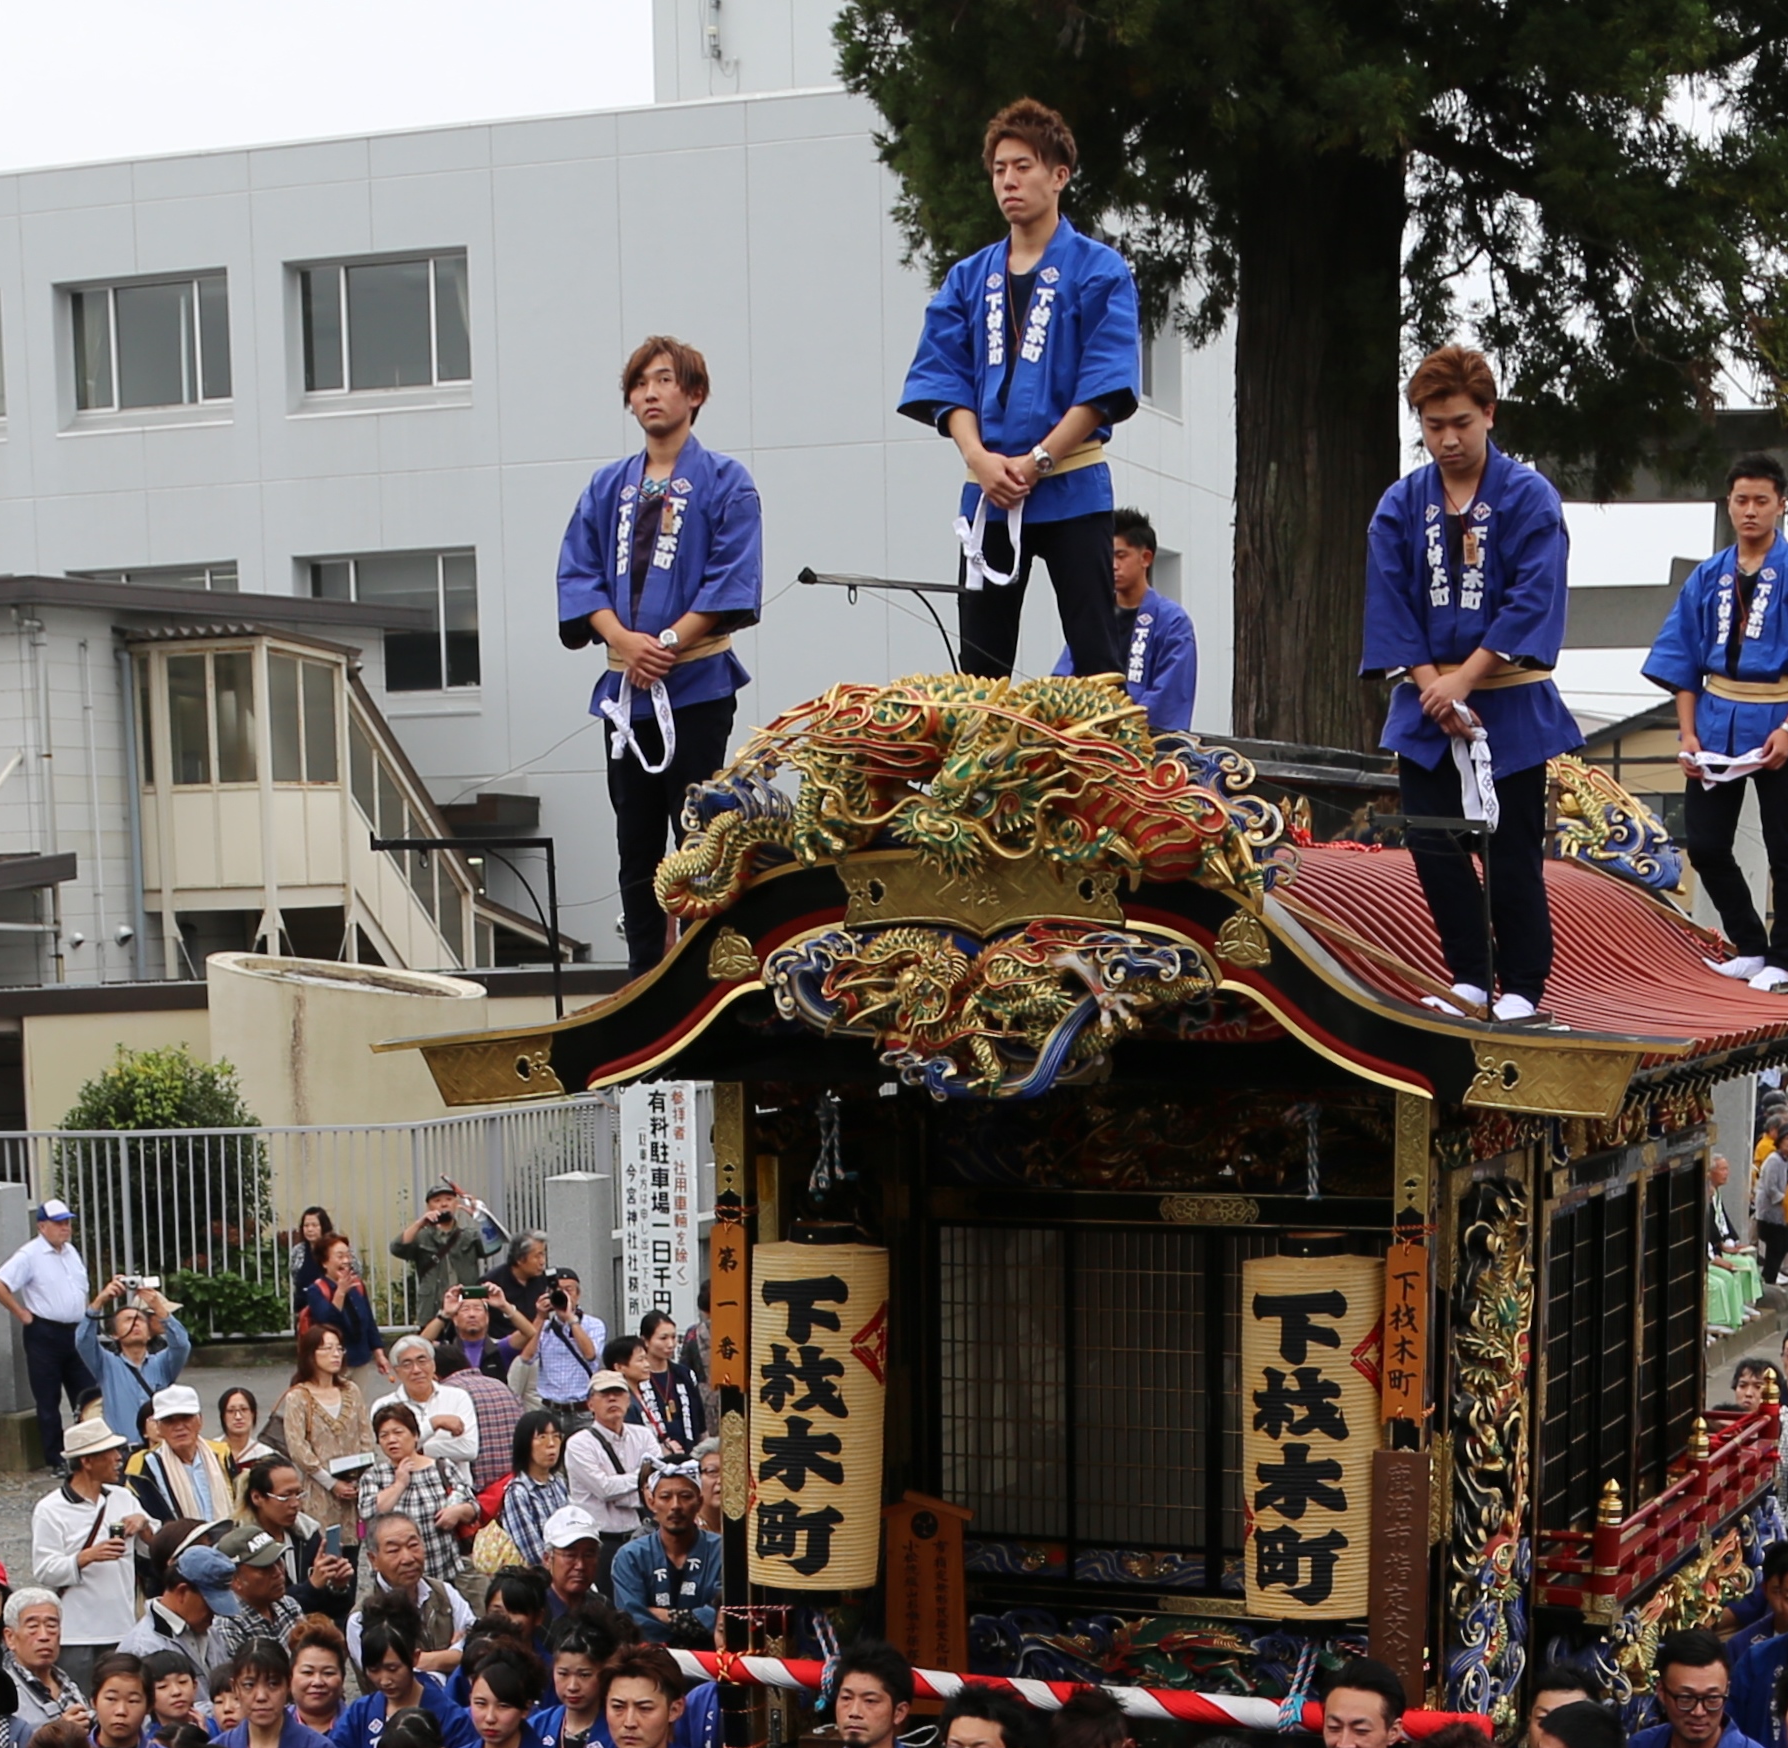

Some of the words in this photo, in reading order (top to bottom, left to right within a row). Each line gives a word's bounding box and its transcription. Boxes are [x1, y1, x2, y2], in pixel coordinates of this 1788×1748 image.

[716, 1246, 739, 1362] 第一番
[1383, 1461, 1416, 1680] 鹿沼市指定文化
